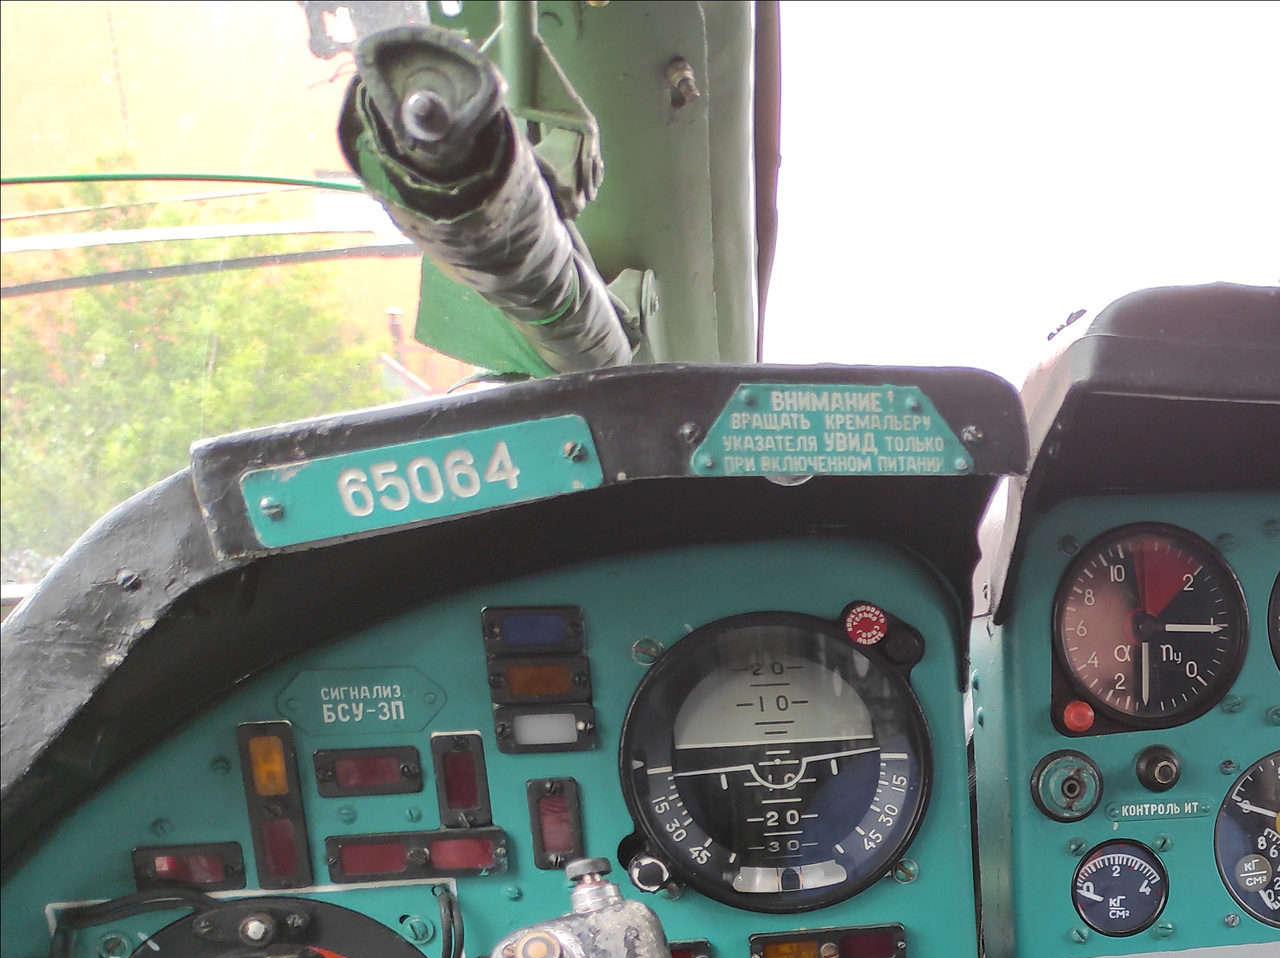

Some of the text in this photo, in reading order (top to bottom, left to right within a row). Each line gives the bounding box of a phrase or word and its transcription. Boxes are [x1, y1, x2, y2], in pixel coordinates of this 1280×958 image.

[731, 413, 931, 431] ВРАЩАТЬ КРЕМАЛЬЕРУ
[722, 433, 945, 456] УКАЗАТЕЛЯ УВИД ТОЛЬКО
[724, 456, 756, 475] ПРИ
[760, 455, 872, 474] ВКЛЮЧЕННОМ
[337, 441, 520, 517] 65064
[1110, 565, 1125, 582] 10
[766, 810, 800, 827] 20
[878, 803, 898, 827] 30
[1121, 802, 1199, 818] КОНТРОЛЬ ИТ
[863, 832, 884, 852] 45
[689, 844, 712, 865] 45
